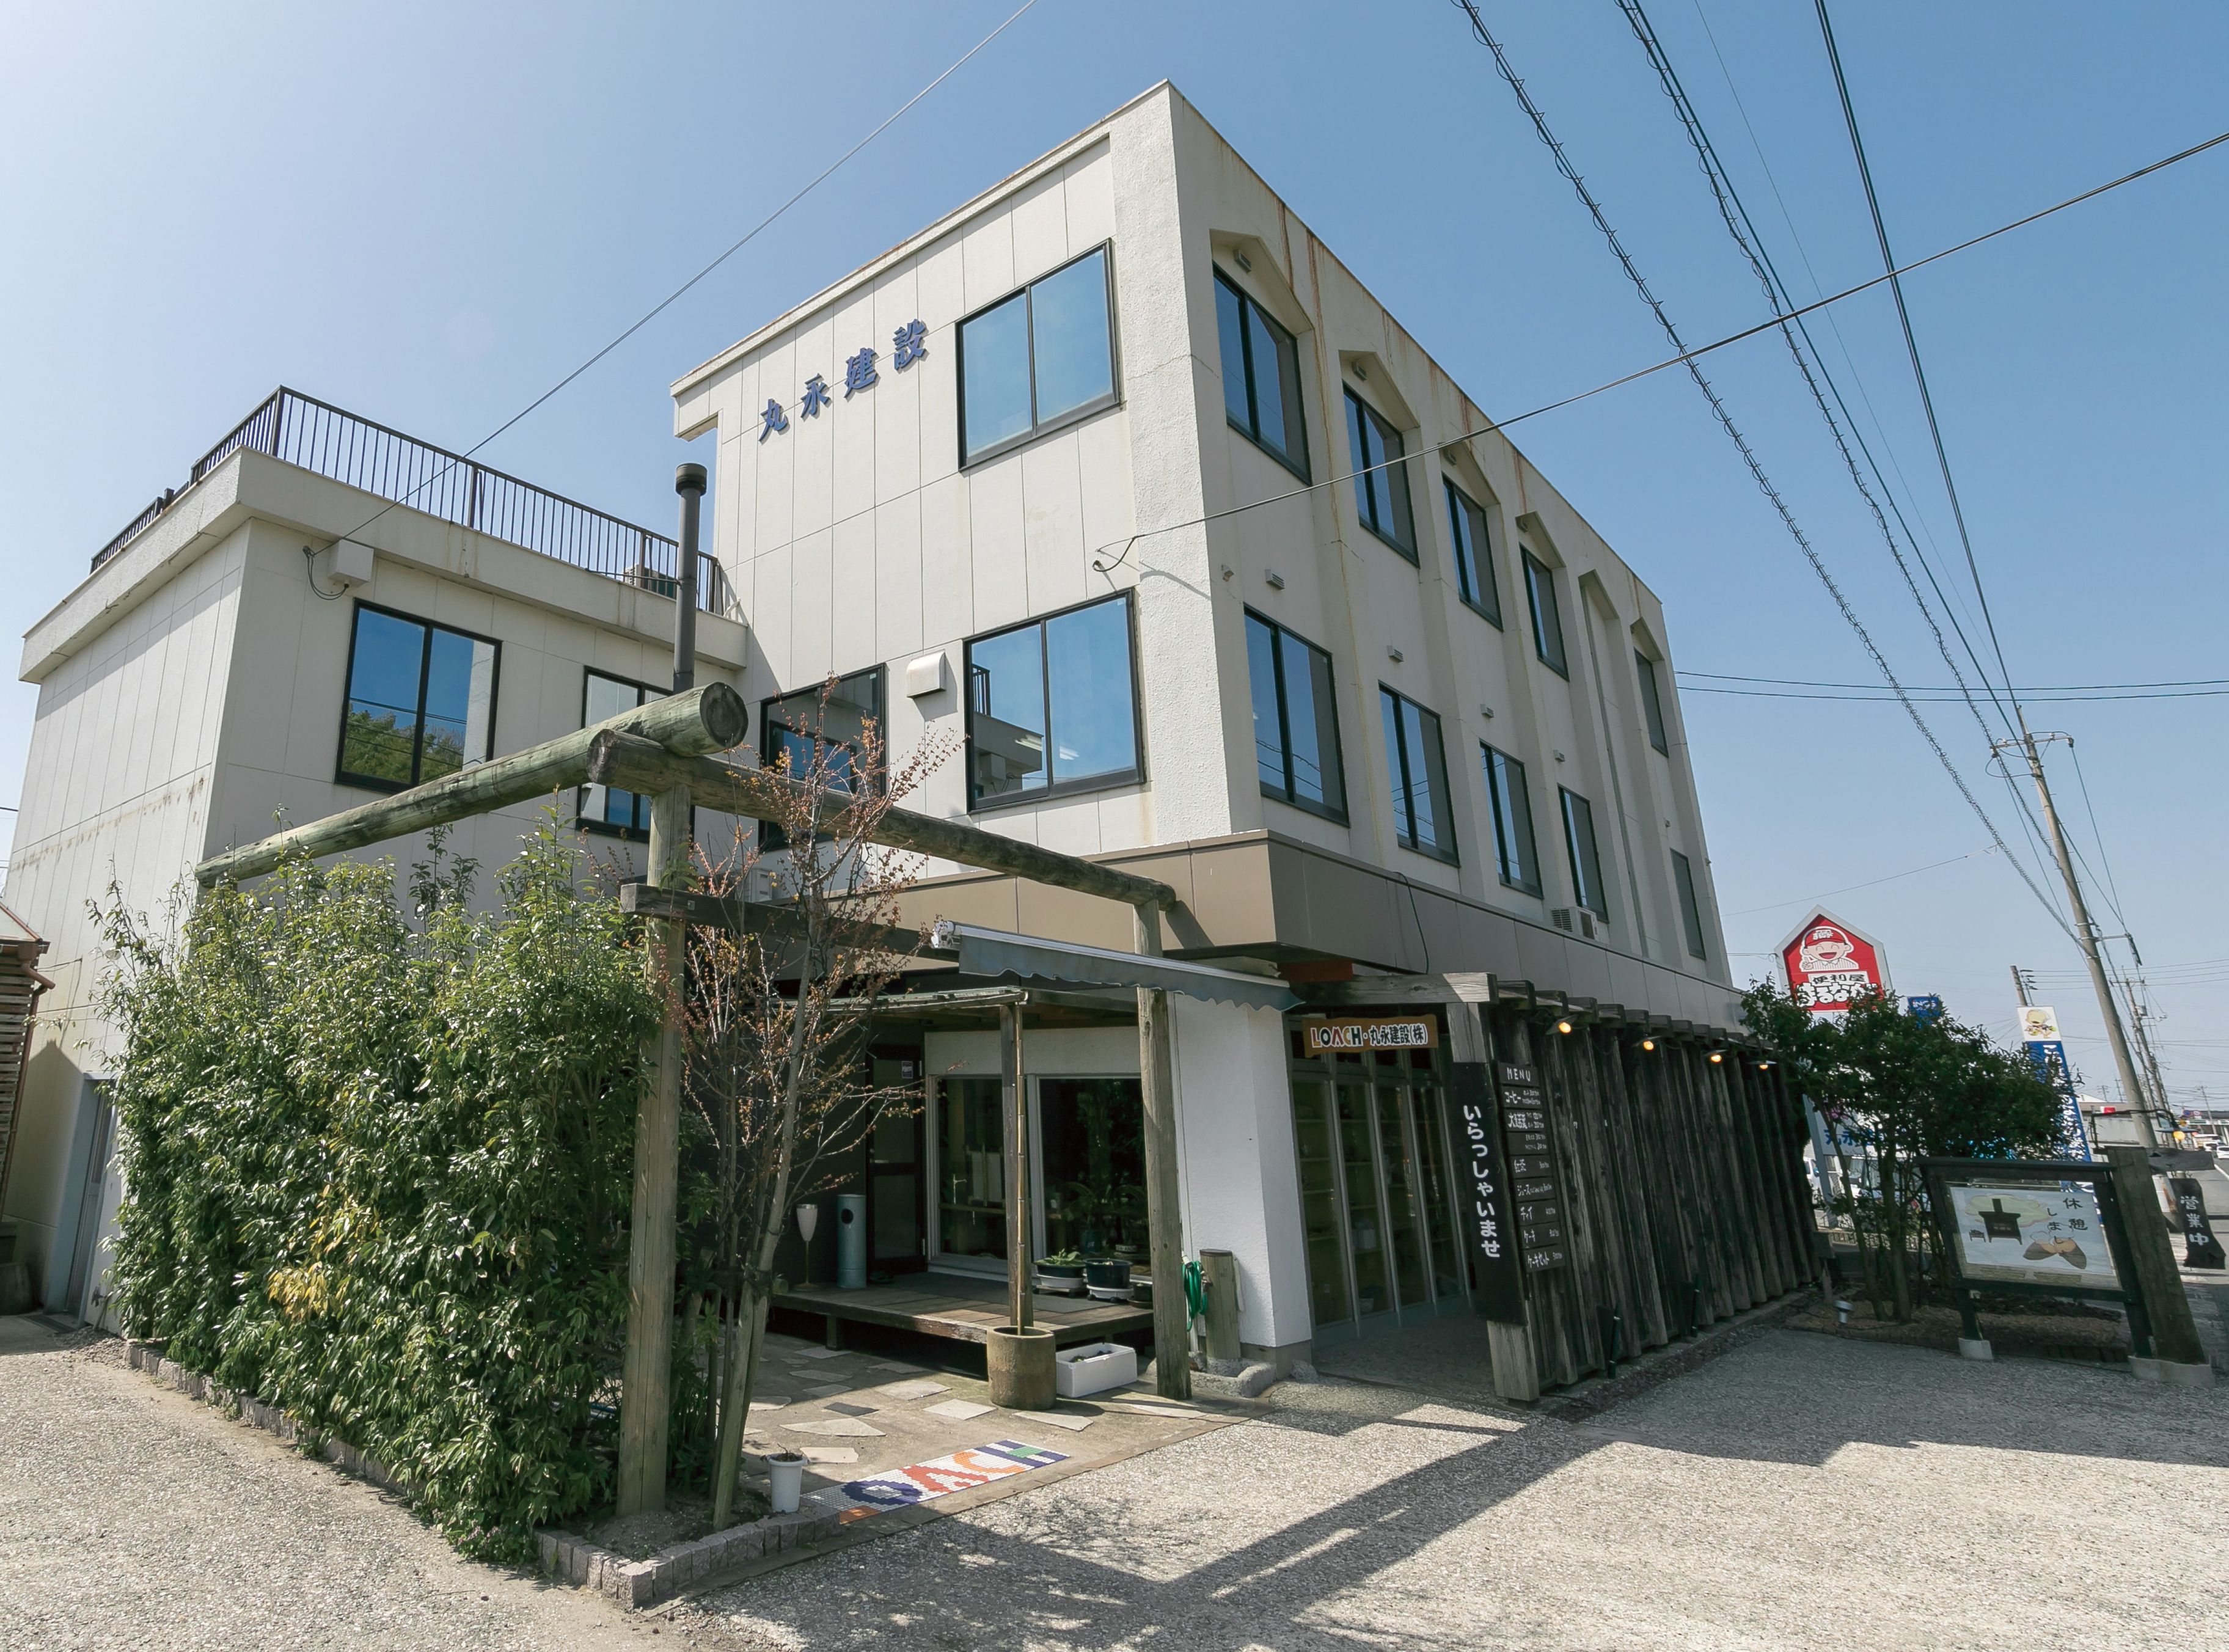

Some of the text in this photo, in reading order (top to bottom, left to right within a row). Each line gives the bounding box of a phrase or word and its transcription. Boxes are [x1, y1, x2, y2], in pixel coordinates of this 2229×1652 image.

[759, 318, 926, 442] 丸永建設
[1812, 973, 1865, 984] 便利屋
[1507, 1067, 1531, 1082] MENU
[1463, 1105, 1501, 1259] いらっしゃいませ
[2062, 1197, 2088, 1231] 休憩
[2180, 1196, 2209, 1246] 営業中
[1523, 1229, 1535, 1244] ケーキ
[1528, 1251, 1550, 1269] ケーキセット
